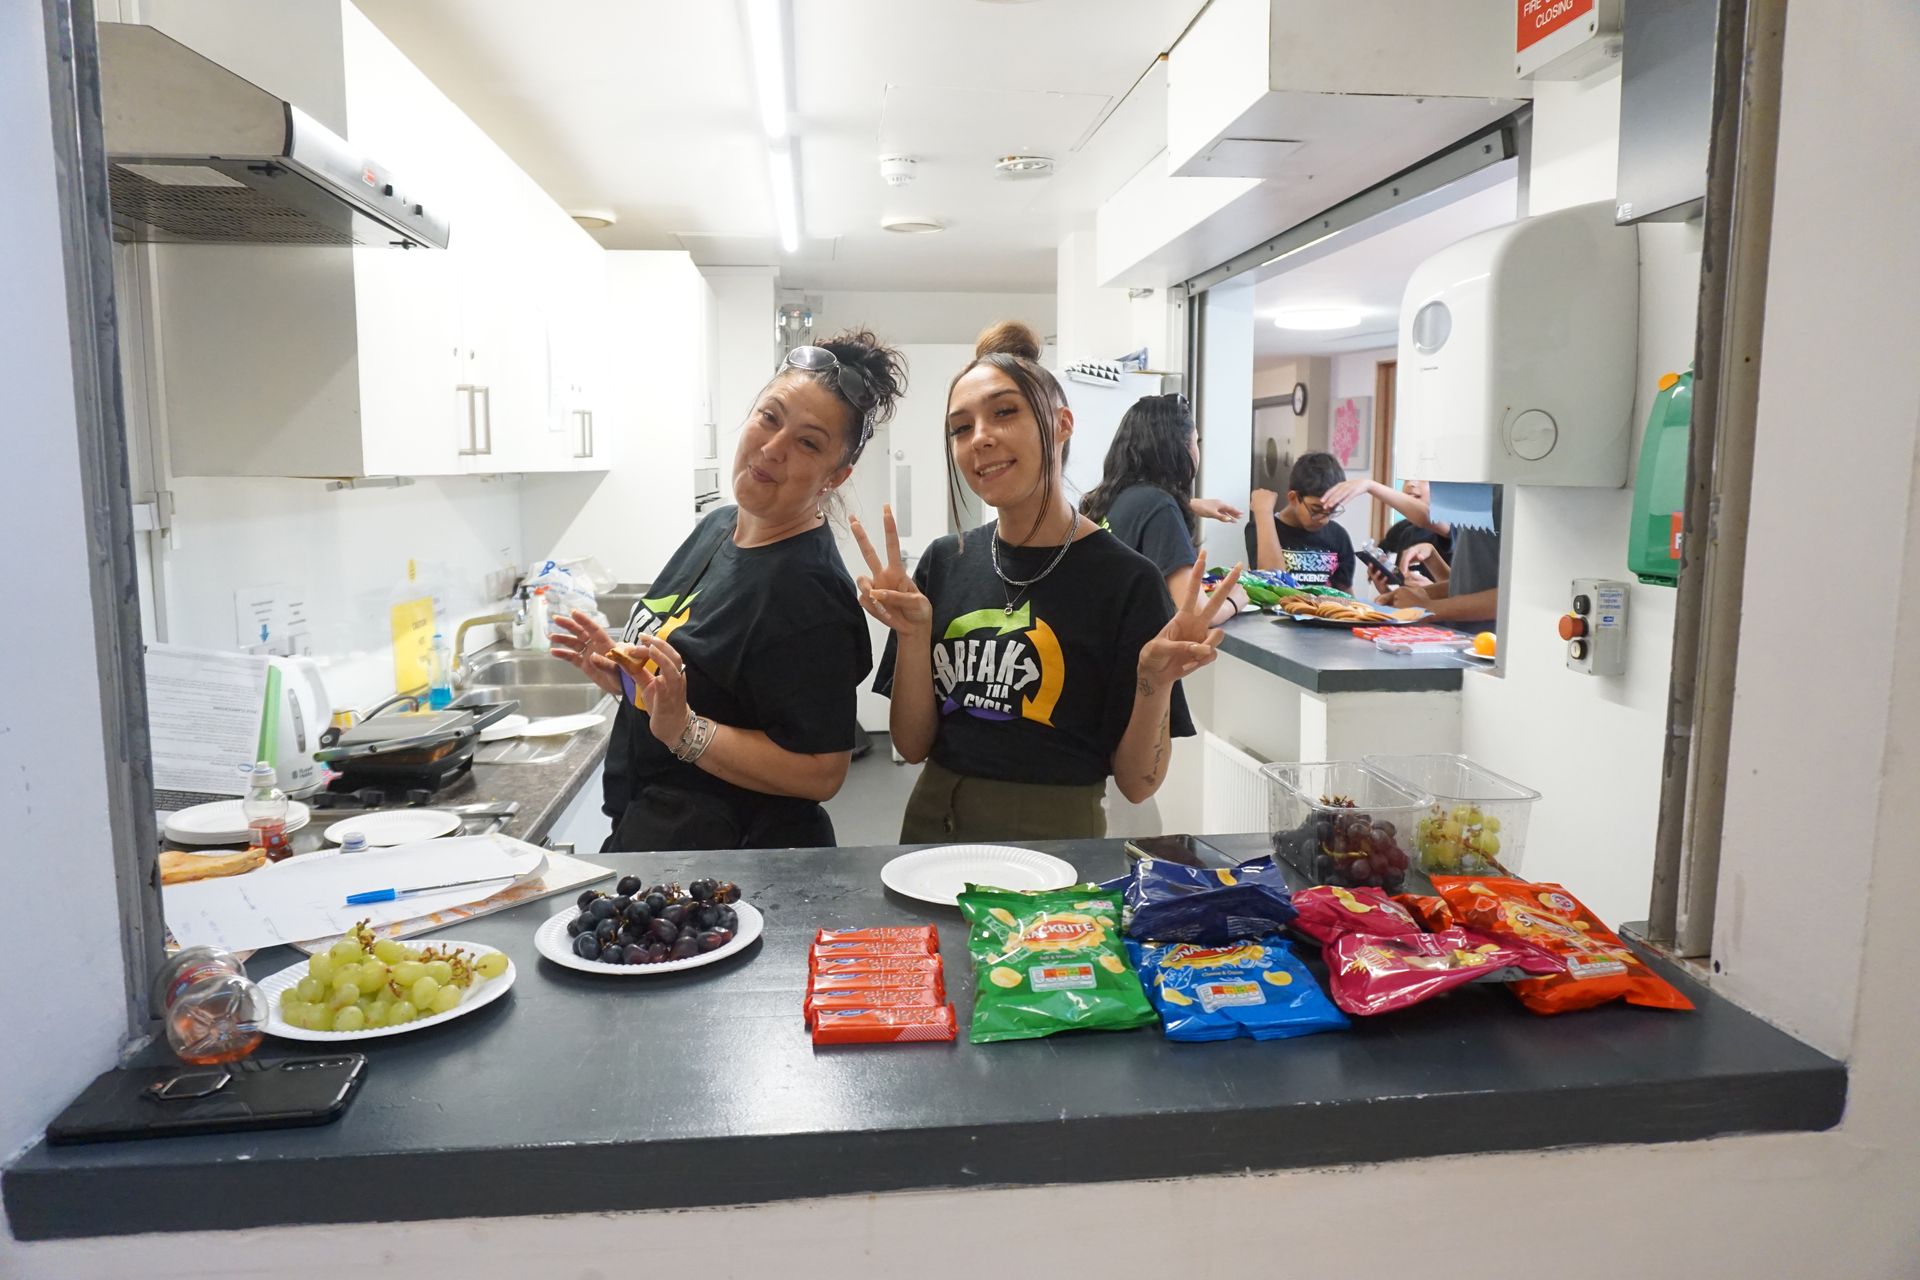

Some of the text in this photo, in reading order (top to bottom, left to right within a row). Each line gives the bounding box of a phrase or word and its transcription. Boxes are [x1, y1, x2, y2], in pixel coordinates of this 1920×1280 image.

[1523, 0, 1541, 17] FIRE
[1536, 0, 1573, 28] CLOSING
[933, 640, 1026, 694] BREAK
[986, 684, 1009, 698] THA
